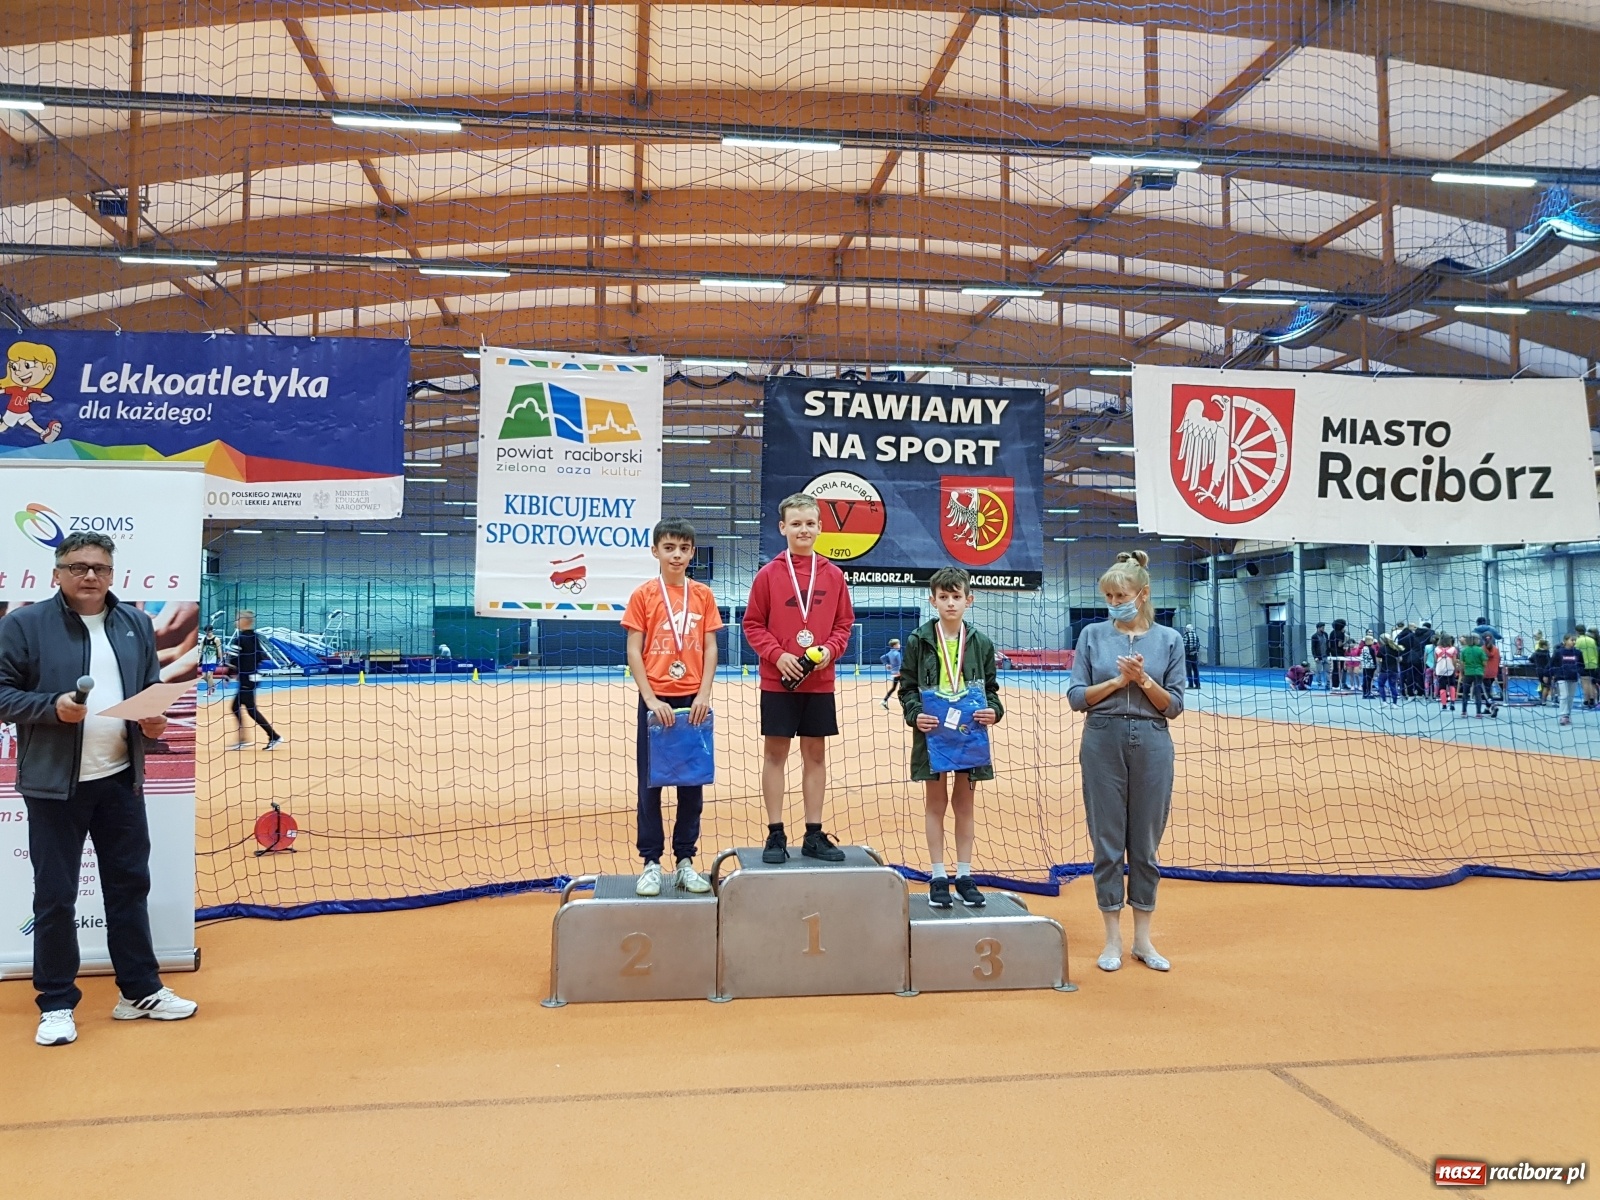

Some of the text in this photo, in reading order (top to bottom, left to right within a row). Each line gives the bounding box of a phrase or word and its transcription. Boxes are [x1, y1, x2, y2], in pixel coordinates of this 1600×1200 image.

[79, 363, 329, 403] Lekkoatletyka
[79, 400, 213, 425] dla każdego!
[804, 390, 1010, 425] STAWIAMY
[1321, 416, 1452, 447] MIASTO
[496, 445, 643, 464] powiat raciborski
[812, 431, 1001, 466] NA SPORT
[496, 461, 642, 477] zielona oaza kultur
[1317, 451, 1554, 503] Racibórz
[205, 491, 230, 506] 00
[335, 503, 381, 511] NARODOWEJ
[504, 493, 636, 522] KIBICUJEMY
[811, 480, 879, 514] TORIA RACIBÓRZ
[69, 516, 134, 531] ZSOMS
[825, 501, 856, 532] V
[486, 522, 650, 548] SPORTOWCOM
[829, 548, 852, 558] 1970
[843, 571, 916, 584] A-RACIBORZ.PL
[969, 574, 1025, 587] ACIBORZ.PL
[801, 912, 826, 956] 1
[620, 931, 653, 977] 2
[972, 937, 1004, 982] 3
